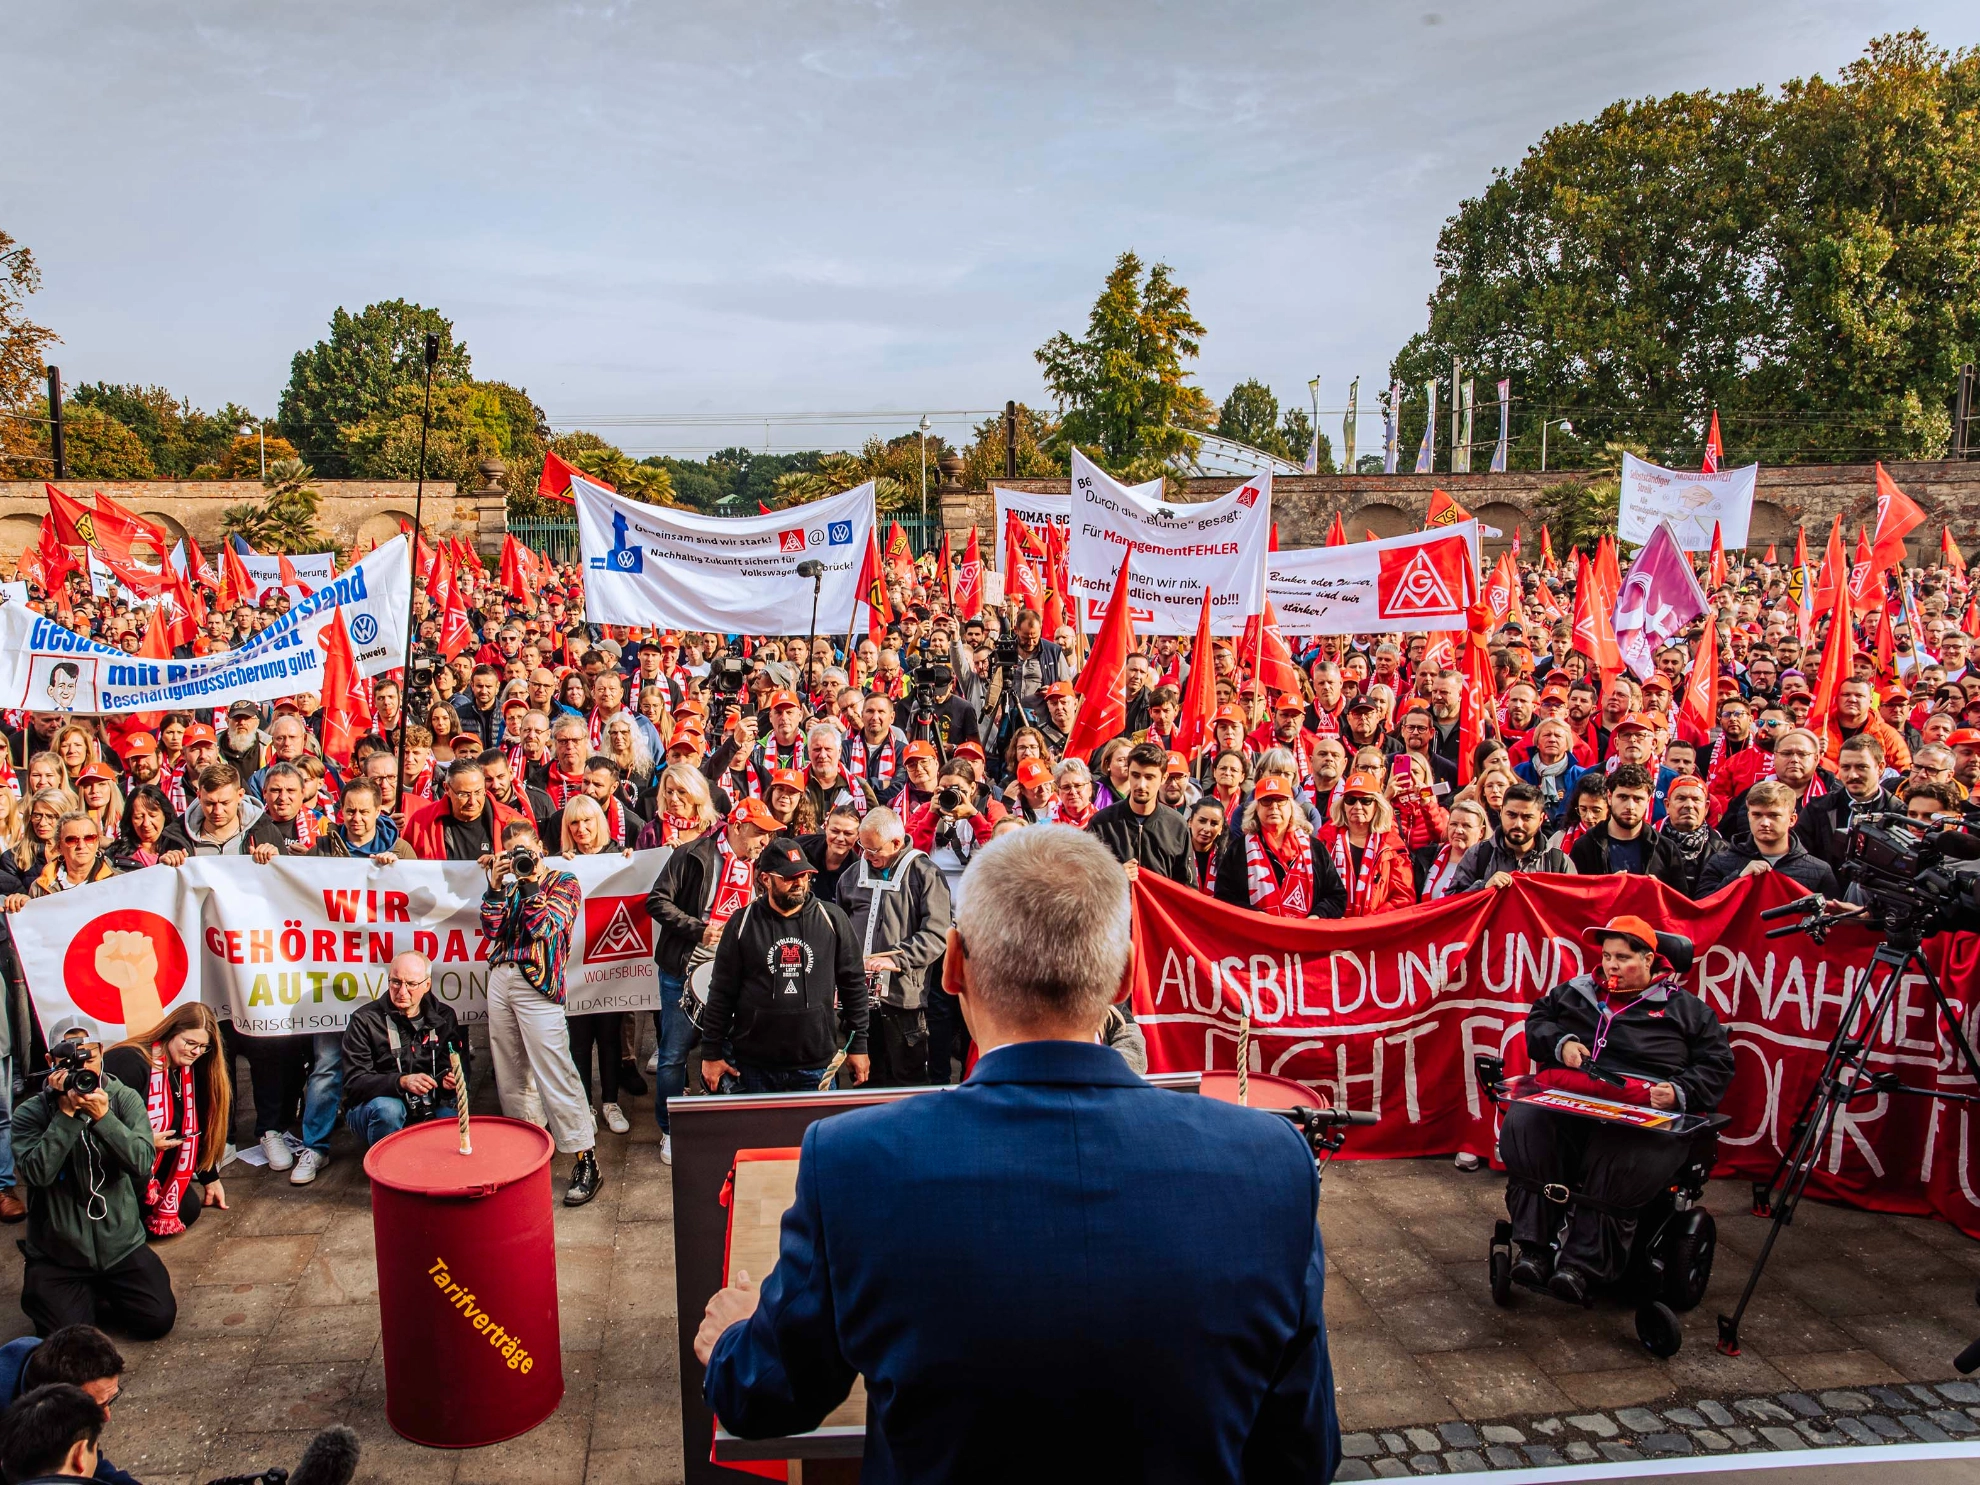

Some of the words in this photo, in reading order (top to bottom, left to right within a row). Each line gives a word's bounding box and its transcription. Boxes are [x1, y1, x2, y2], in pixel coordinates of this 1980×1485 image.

[1077, 477, 1092, 489] B6
[1055, 514, 1071, 525] SC
[1086, 489, 1120, 512] Durch
[1121, 506, 1138, 519] die
[1198, 508, 1243, 531] gesagt:
[696, 536, 719, 546] sind
[720, 538, 737, 546] wir
[740, 536, 772, 546] stark!
[1082, 523, 1102, 538] Für
[1103, 529, 1239, 556] ManagementFEHLER
[650, 548, 703, 564] Nachhaltig
[704, 556, 743, 567] Zukunft
[745, 557, 780, 566] sichern
[781, 555, 797, 564] für
[1111, 565, 1154, 585] knen
[1157, 577, 1176, 588] wir
[1180, 577, 1201, 588] nix.
[1269, 571, 1307, 585] Banker
[1311, 578, 1334, 588] oder
[1070, 575, 1111, 592] Macht
[1210, 593, 1239, 606] ob!!!
[1316, 590, 1340, 601] sind
[1342, 594, 1360, 605] wir
[1282, 602, 1328, 617] stärker!
[102, 658, 288, 710] Beschäftigungssicherung
[288, 648, 318, 676] gilt!
[107, 663, 161, 686] mit
[323, 889, 411, 923] WIR
[205, 919, 394, 965] GEHÖREN
[413, 928, 493, 963] DAZ
[584, 964, 653, 984] WOLFSBURG
[1155, 942, 1469, 1022] AUSBILDUNG
[1481, 930, 1585, 996] UND
[1695, 945, 1939, 1052] RNAHME
[428, 1256, 534, 1375] Tarifverträge
